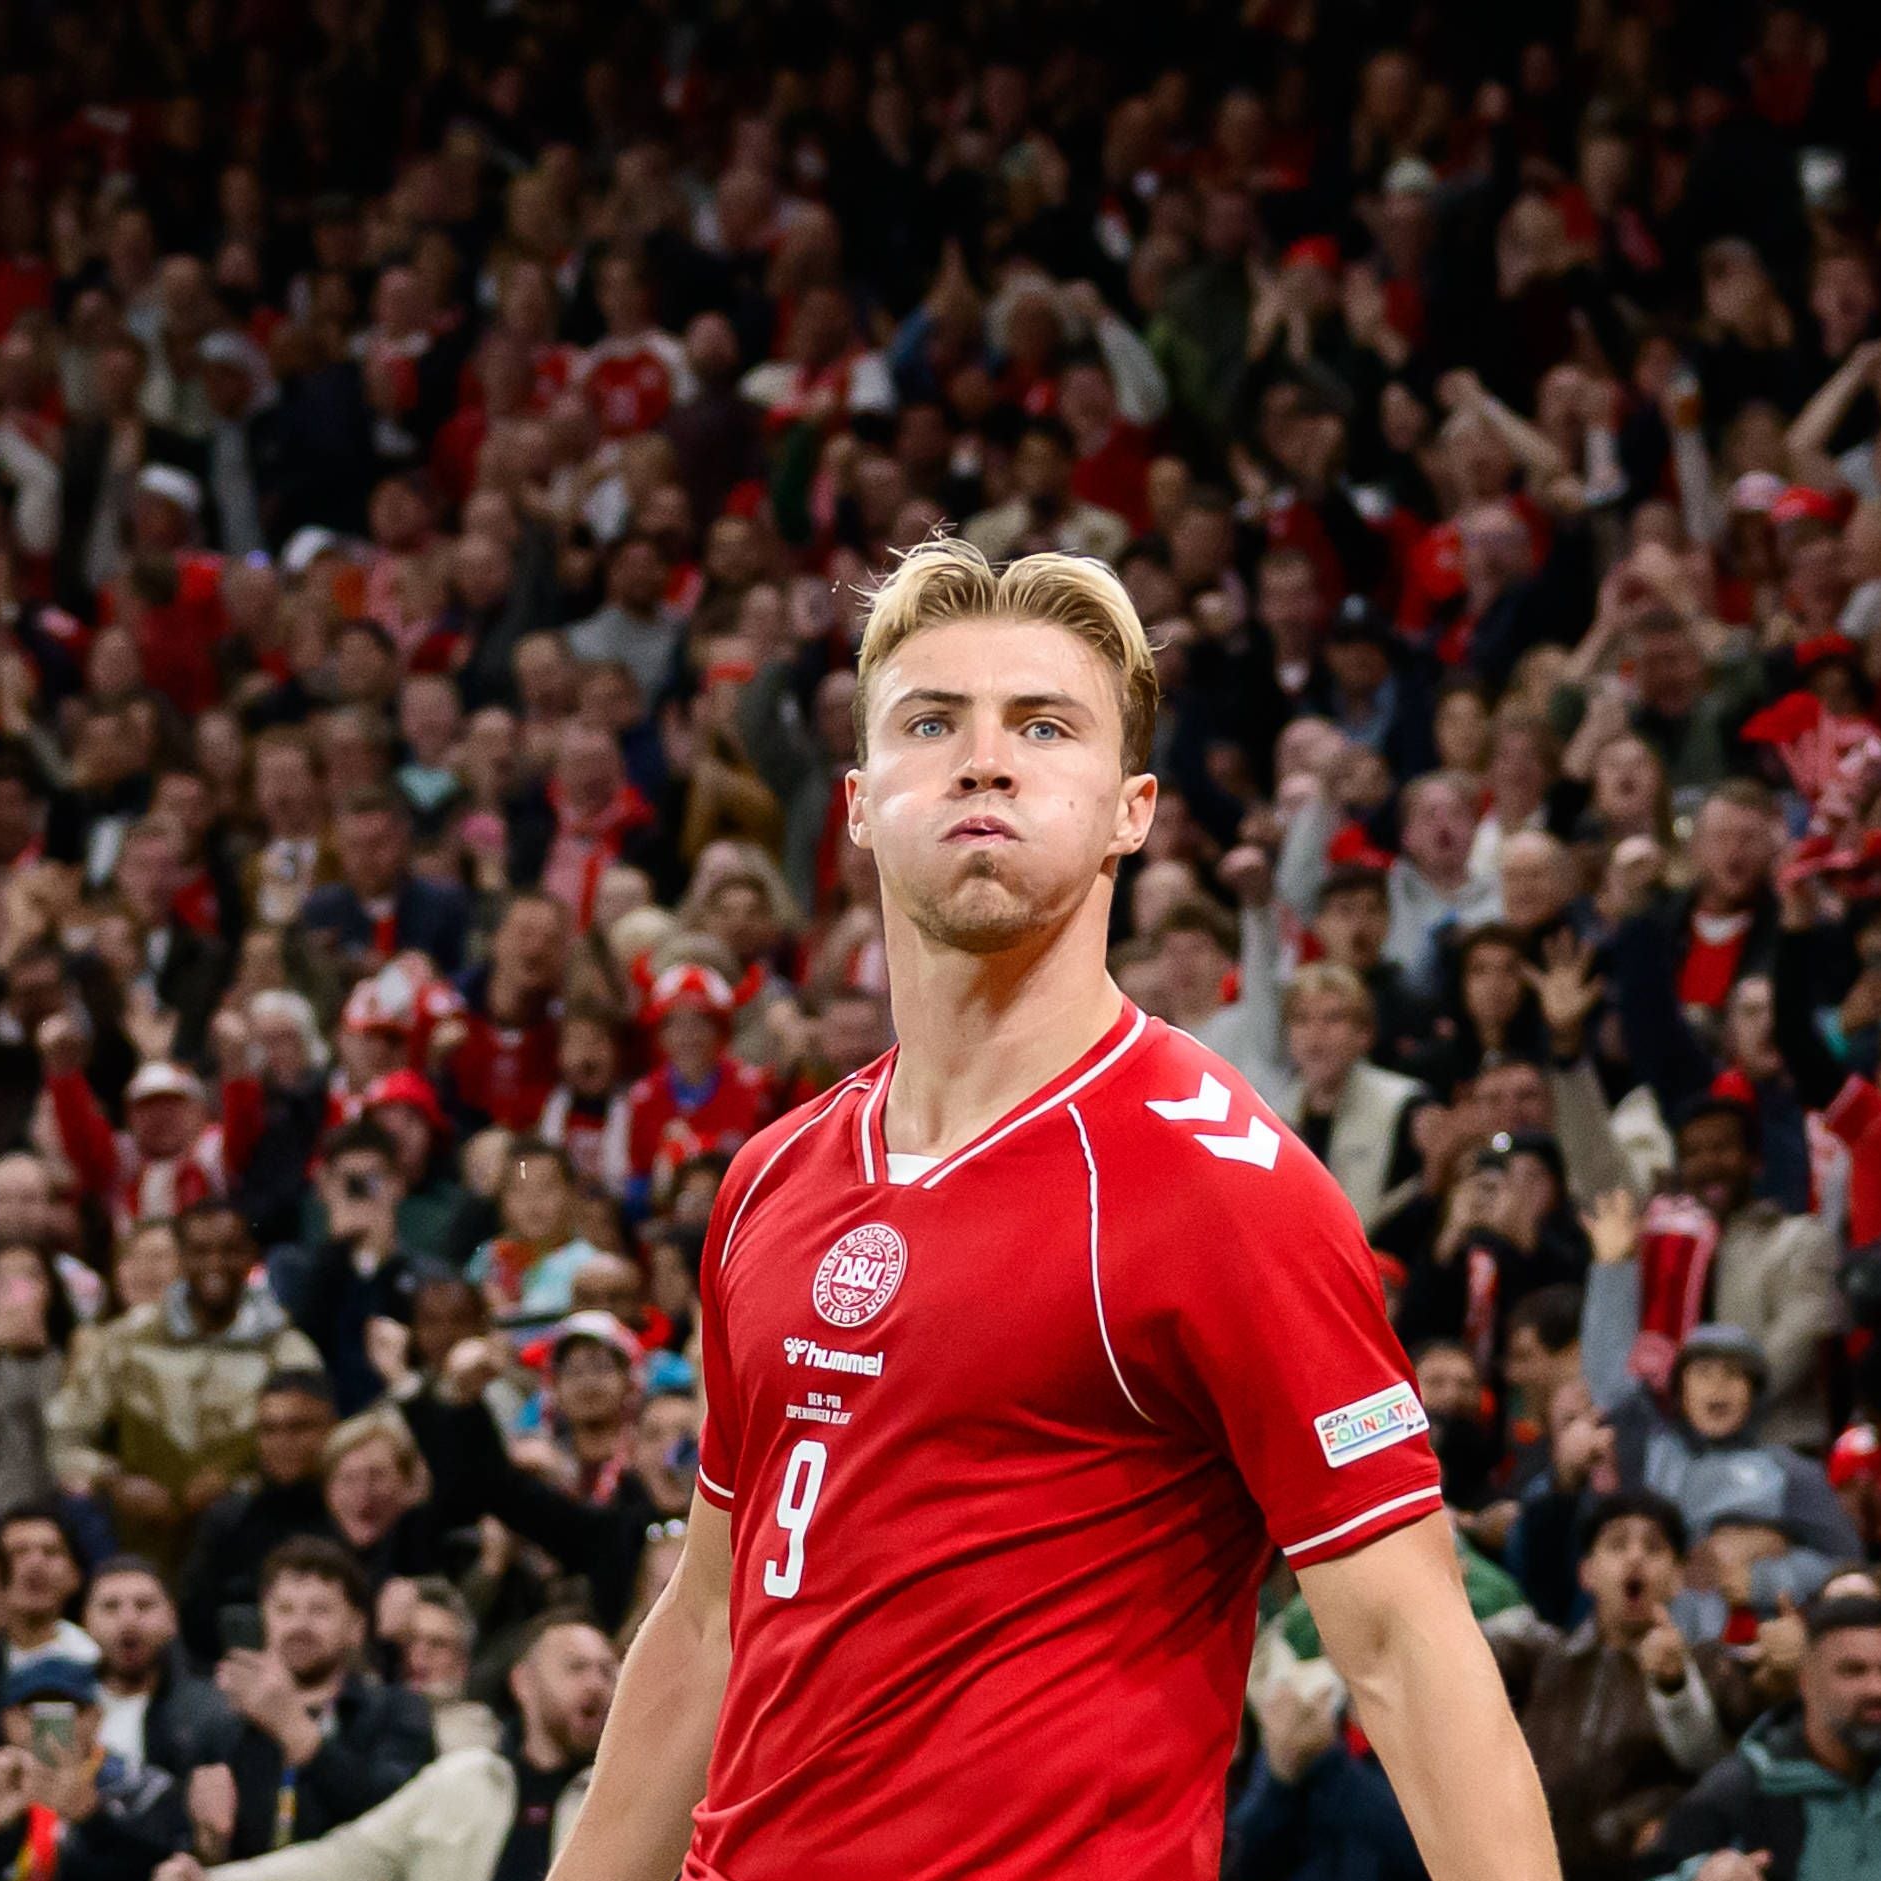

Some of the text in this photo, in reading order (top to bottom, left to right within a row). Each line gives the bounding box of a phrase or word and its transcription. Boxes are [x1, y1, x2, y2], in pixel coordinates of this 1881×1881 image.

[831, 1255, 885, 1290] DBU
[826, 1304, 860, 1323] 1889
[804, 1341, 884, 1377] hummel
[1320, 1412, 1349, 1431] UEFA
[763, 1439, 827, 1599] 9
